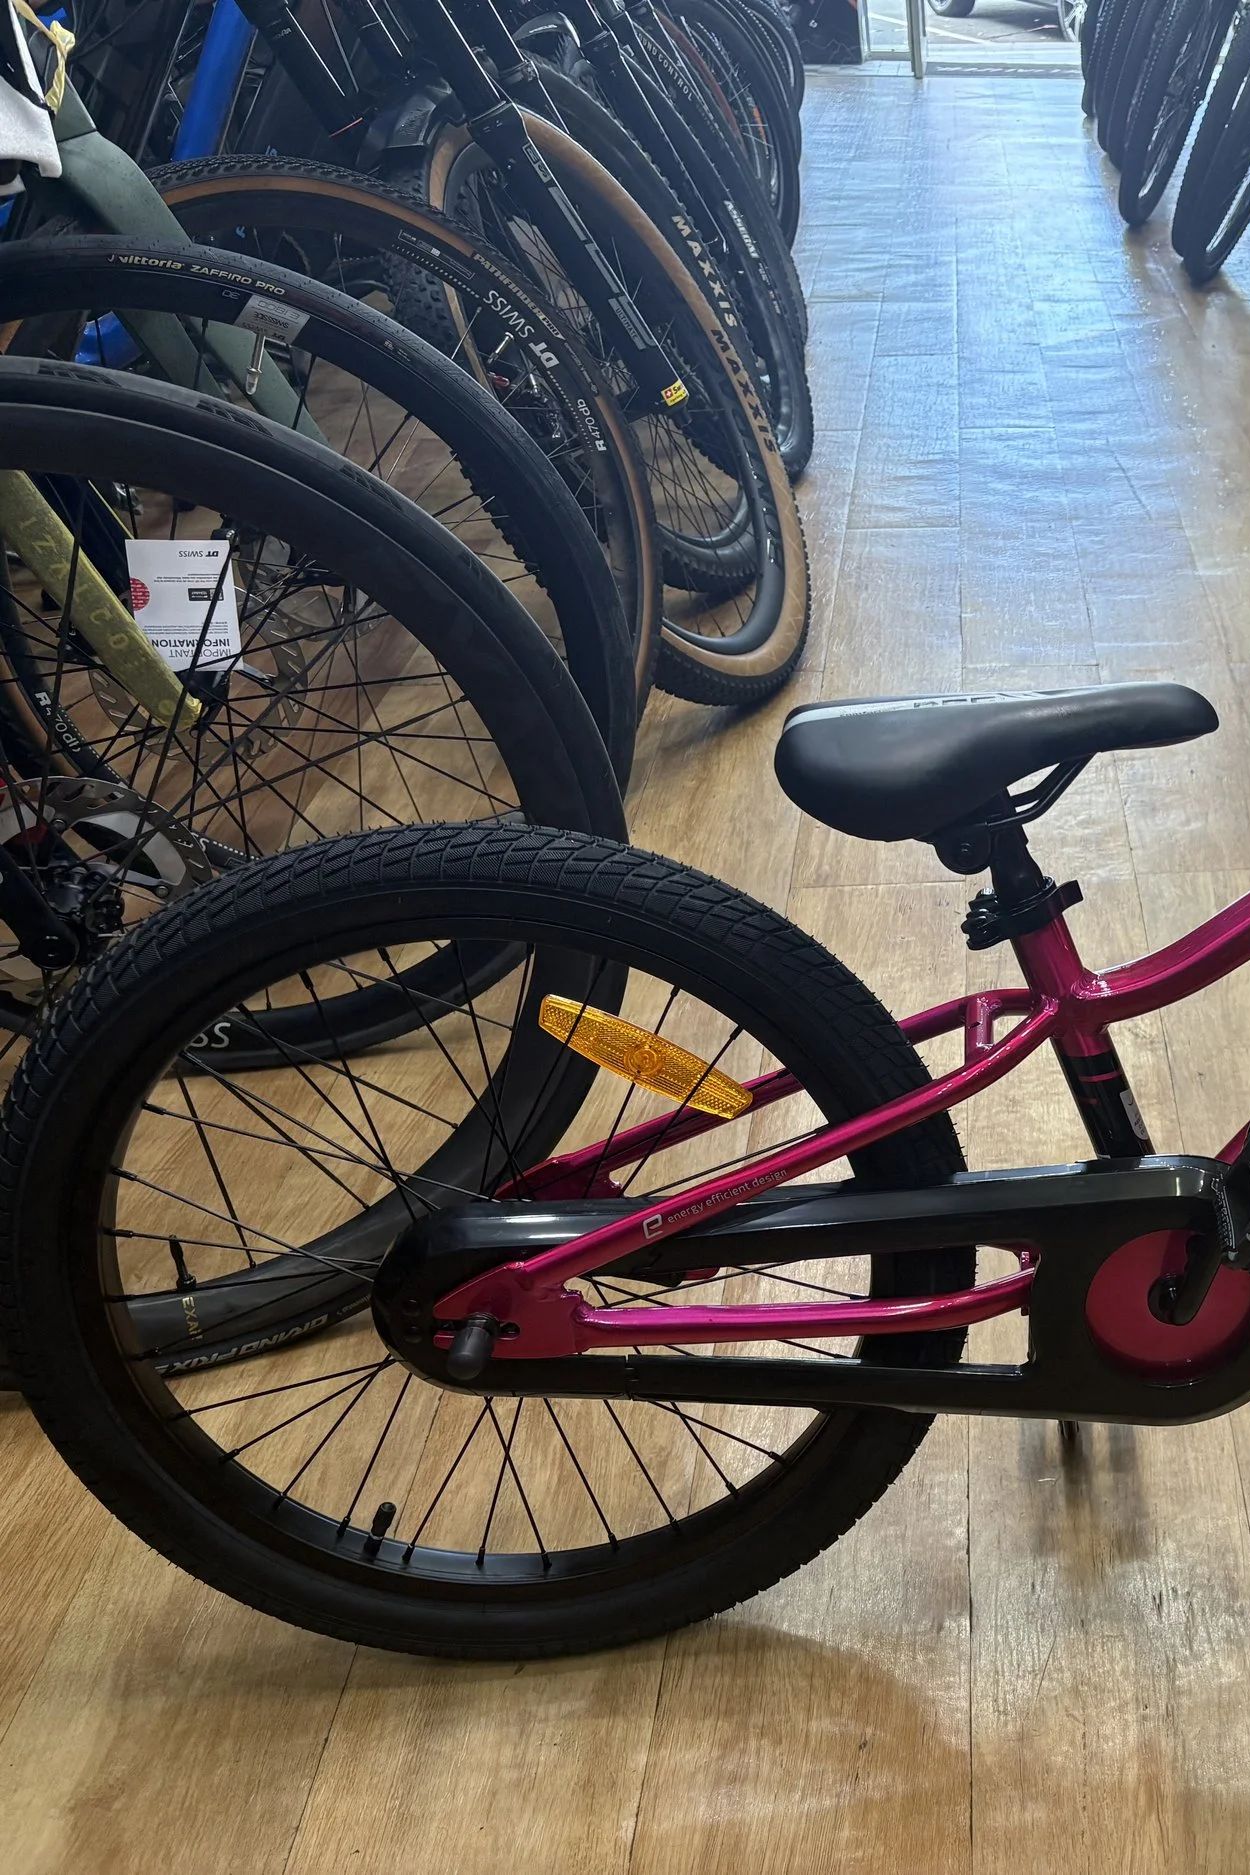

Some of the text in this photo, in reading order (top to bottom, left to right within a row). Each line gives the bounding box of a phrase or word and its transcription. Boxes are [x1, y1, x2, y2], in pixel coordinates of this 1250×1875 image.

[119, 255, 286, 296] vittoria ZAFFIRO PRO
[671, 214, 738, 329] MAXXIS
[483, 289, 561, 368] DT SWISS
[711, 328, 777, 454] MAXXIS
[178, 550, 220, 558] DT SWISS
[667, 1201, 704, 1225] energy
[704, 1183, 752, 1208] efficient
[751, 1168, 788, 1190] design
